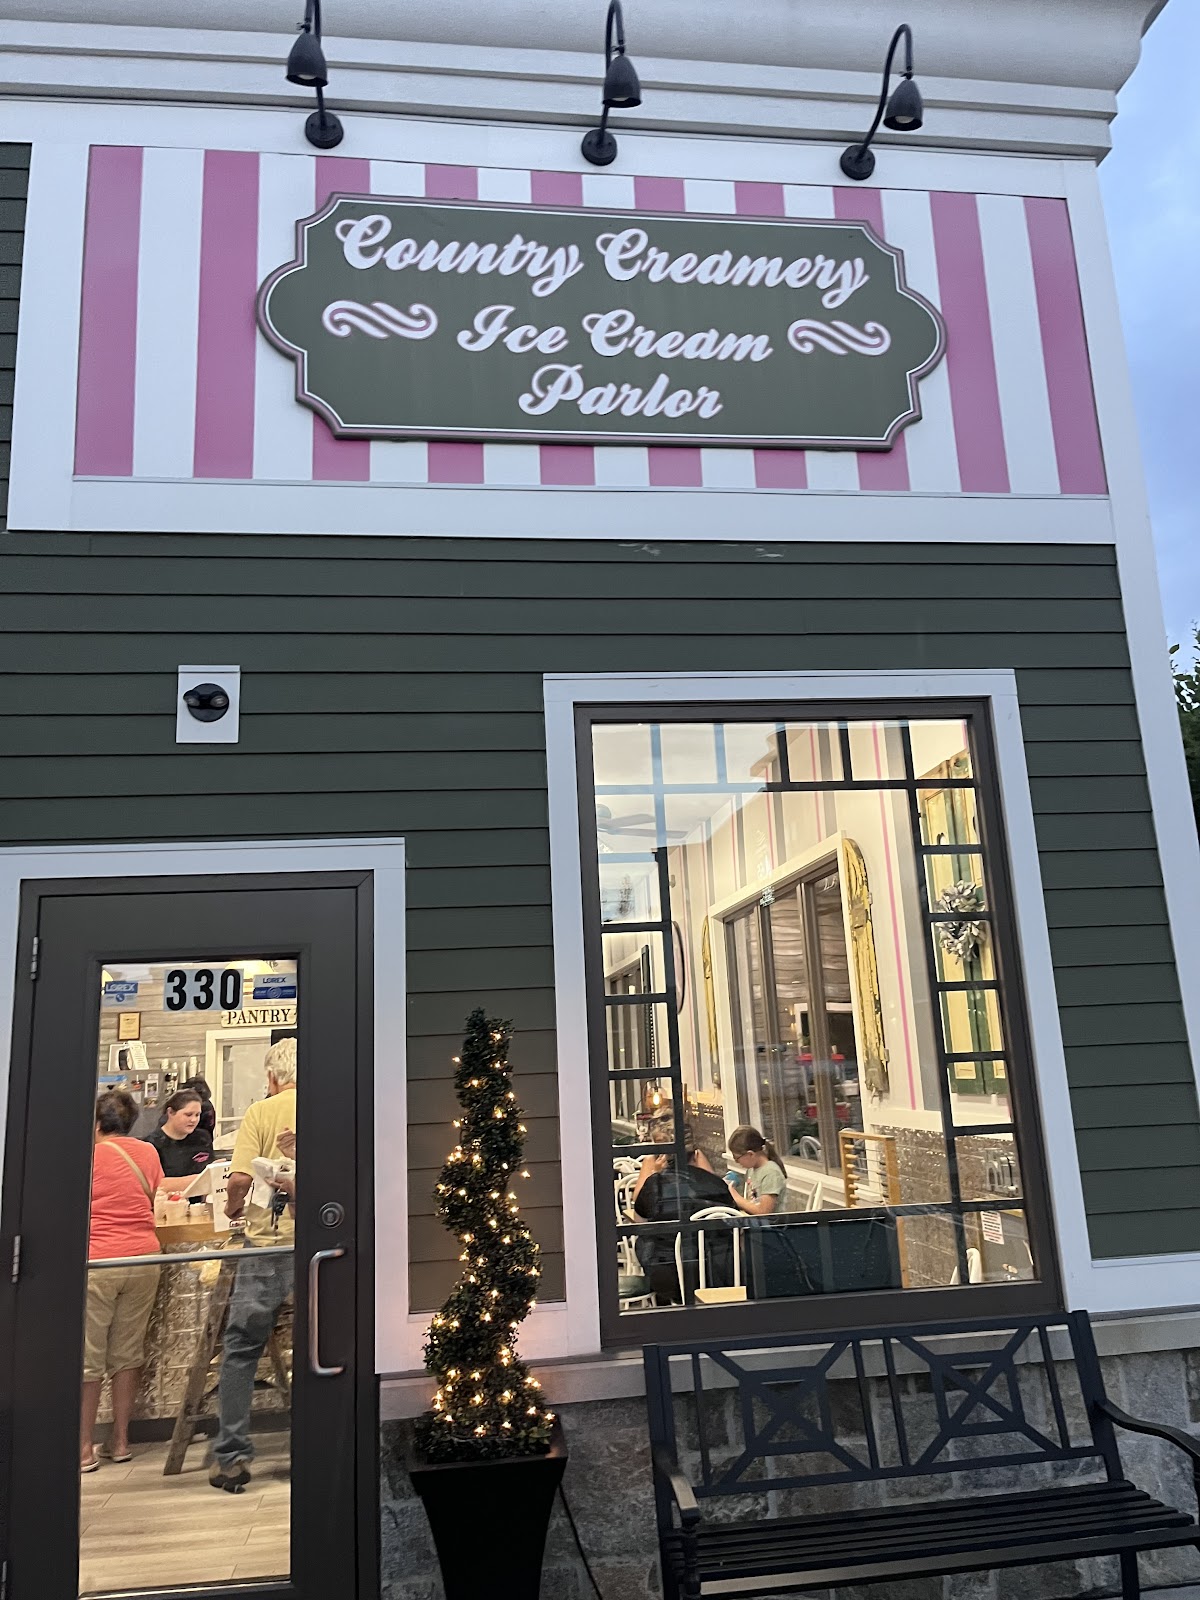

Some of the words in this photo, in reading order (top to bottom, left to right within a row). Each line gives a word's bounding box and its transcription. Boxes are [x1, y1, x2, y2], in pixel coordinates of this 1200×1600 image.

[335, 214, 584, 297] Country
[595, 228, 870, 309] Creamery
[456, 304, 569, 353] Ice
[582, 309, 774, 362] Cream
[518, 363, 724, 419] Parlor
[166, 969, 241, 1011] 330
[227, 1008, 291, 1025] PANTRY
